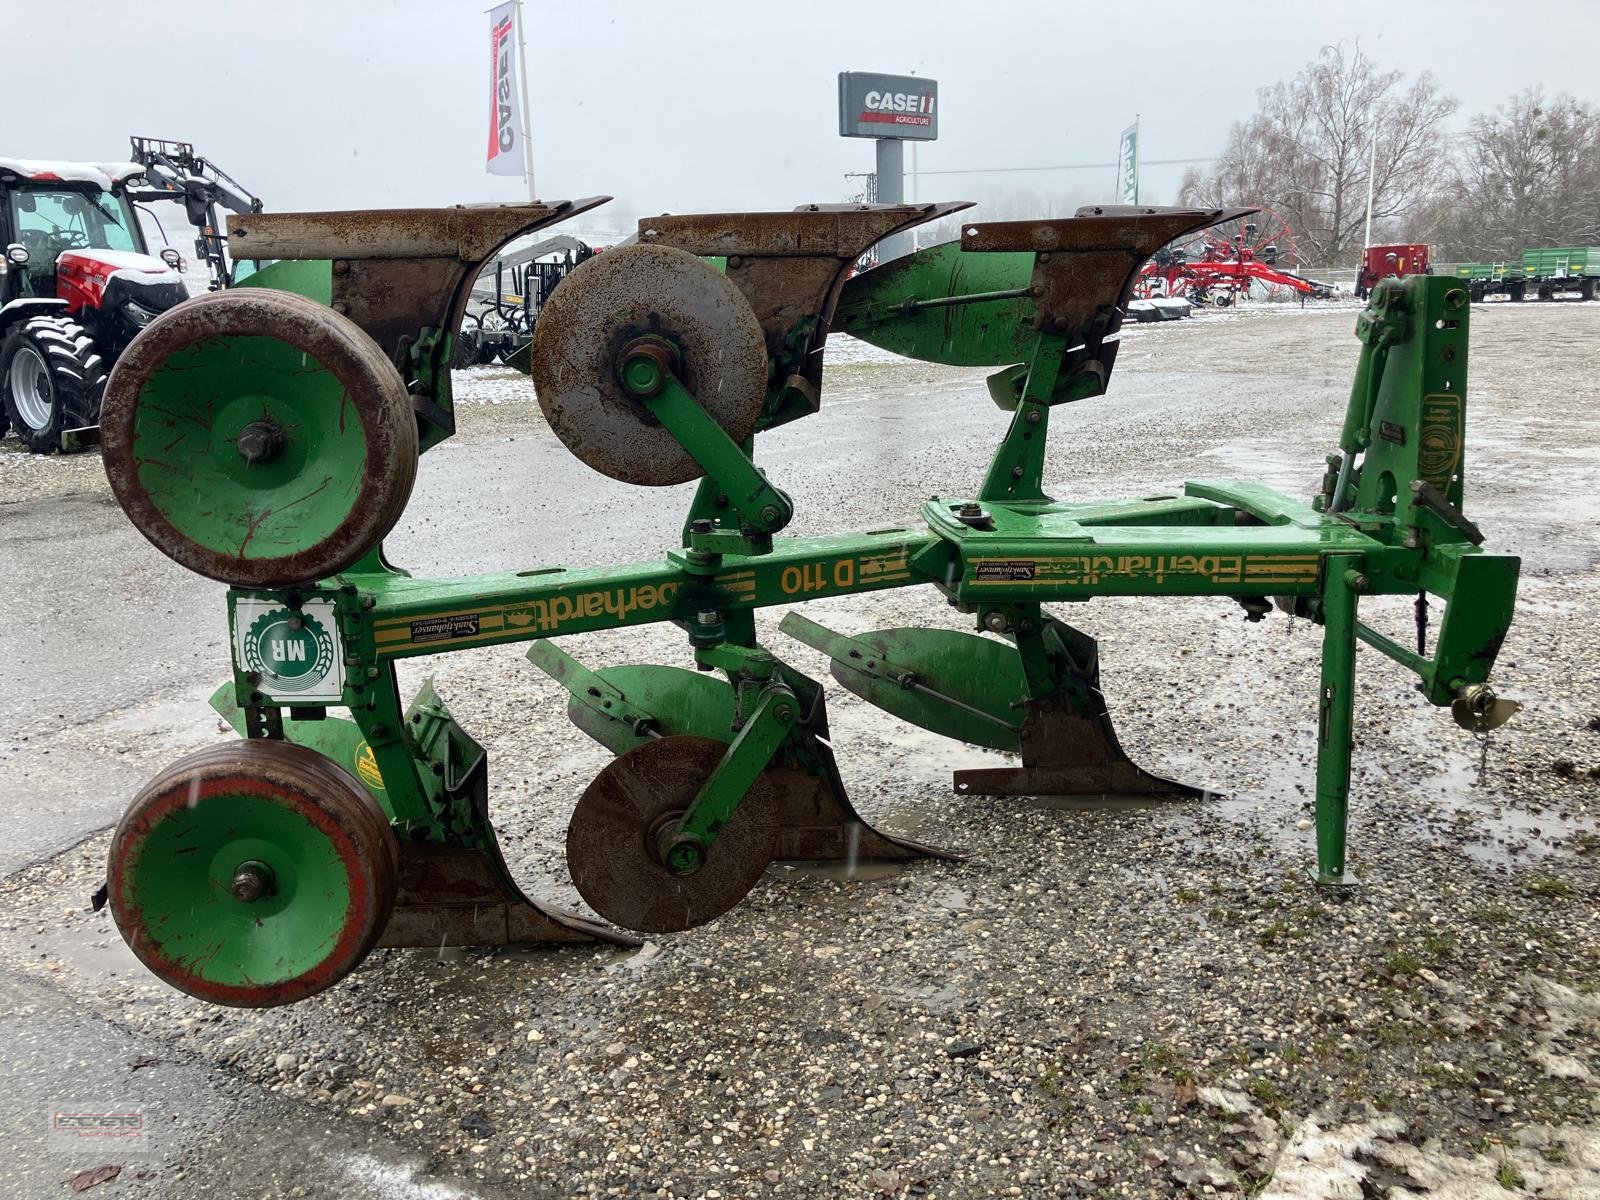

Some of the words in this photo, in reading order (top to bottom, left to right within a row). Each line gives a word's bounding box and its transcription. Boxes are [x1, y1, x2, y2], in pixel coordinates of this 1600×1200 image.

[865, 91, 918, 112] CASE
[895, 115, 929, 125] AGRICULTURE
[781, 562, 828, 594] 110
[834, 560, 854, 587] D
[1080, 556, 1242, 584] Eberhardt
[536, 582, 678, 630] berhardt
[413, 620, 478, 634] Sanktjohanser
[271, 639, 306, 662] MR
